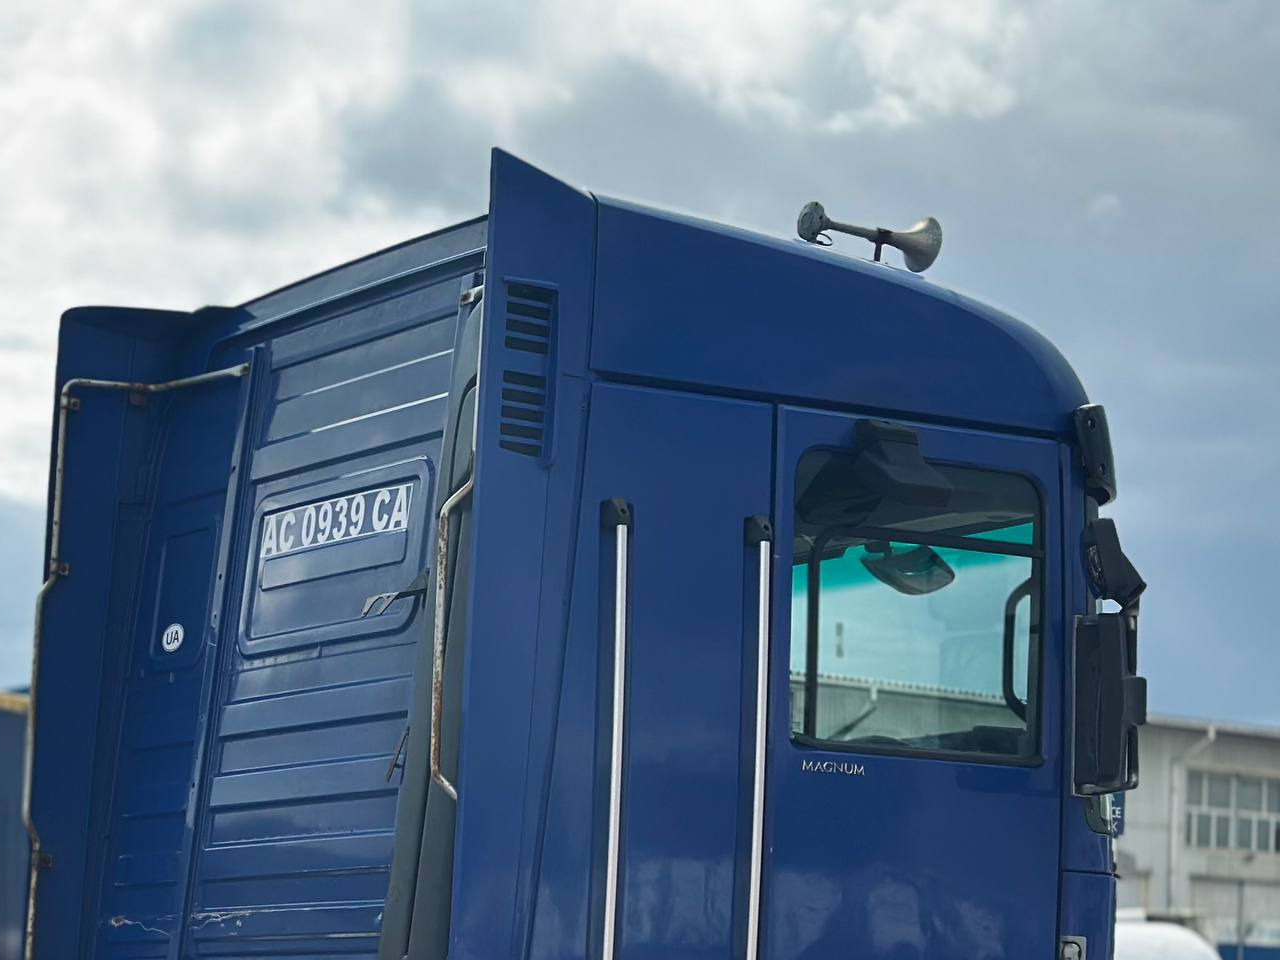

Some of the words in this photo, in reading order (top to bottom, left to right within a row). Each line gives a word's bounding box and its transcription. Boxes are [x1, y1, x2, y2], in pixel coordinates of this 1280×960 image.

[262, 511, 296, 556] AC
[301, 494, 365, 546] 0939
[372, 485, 408, 531] CA
[166, 630, 179, 645] UA
[802, 760, 865, 775] MAGNUM
